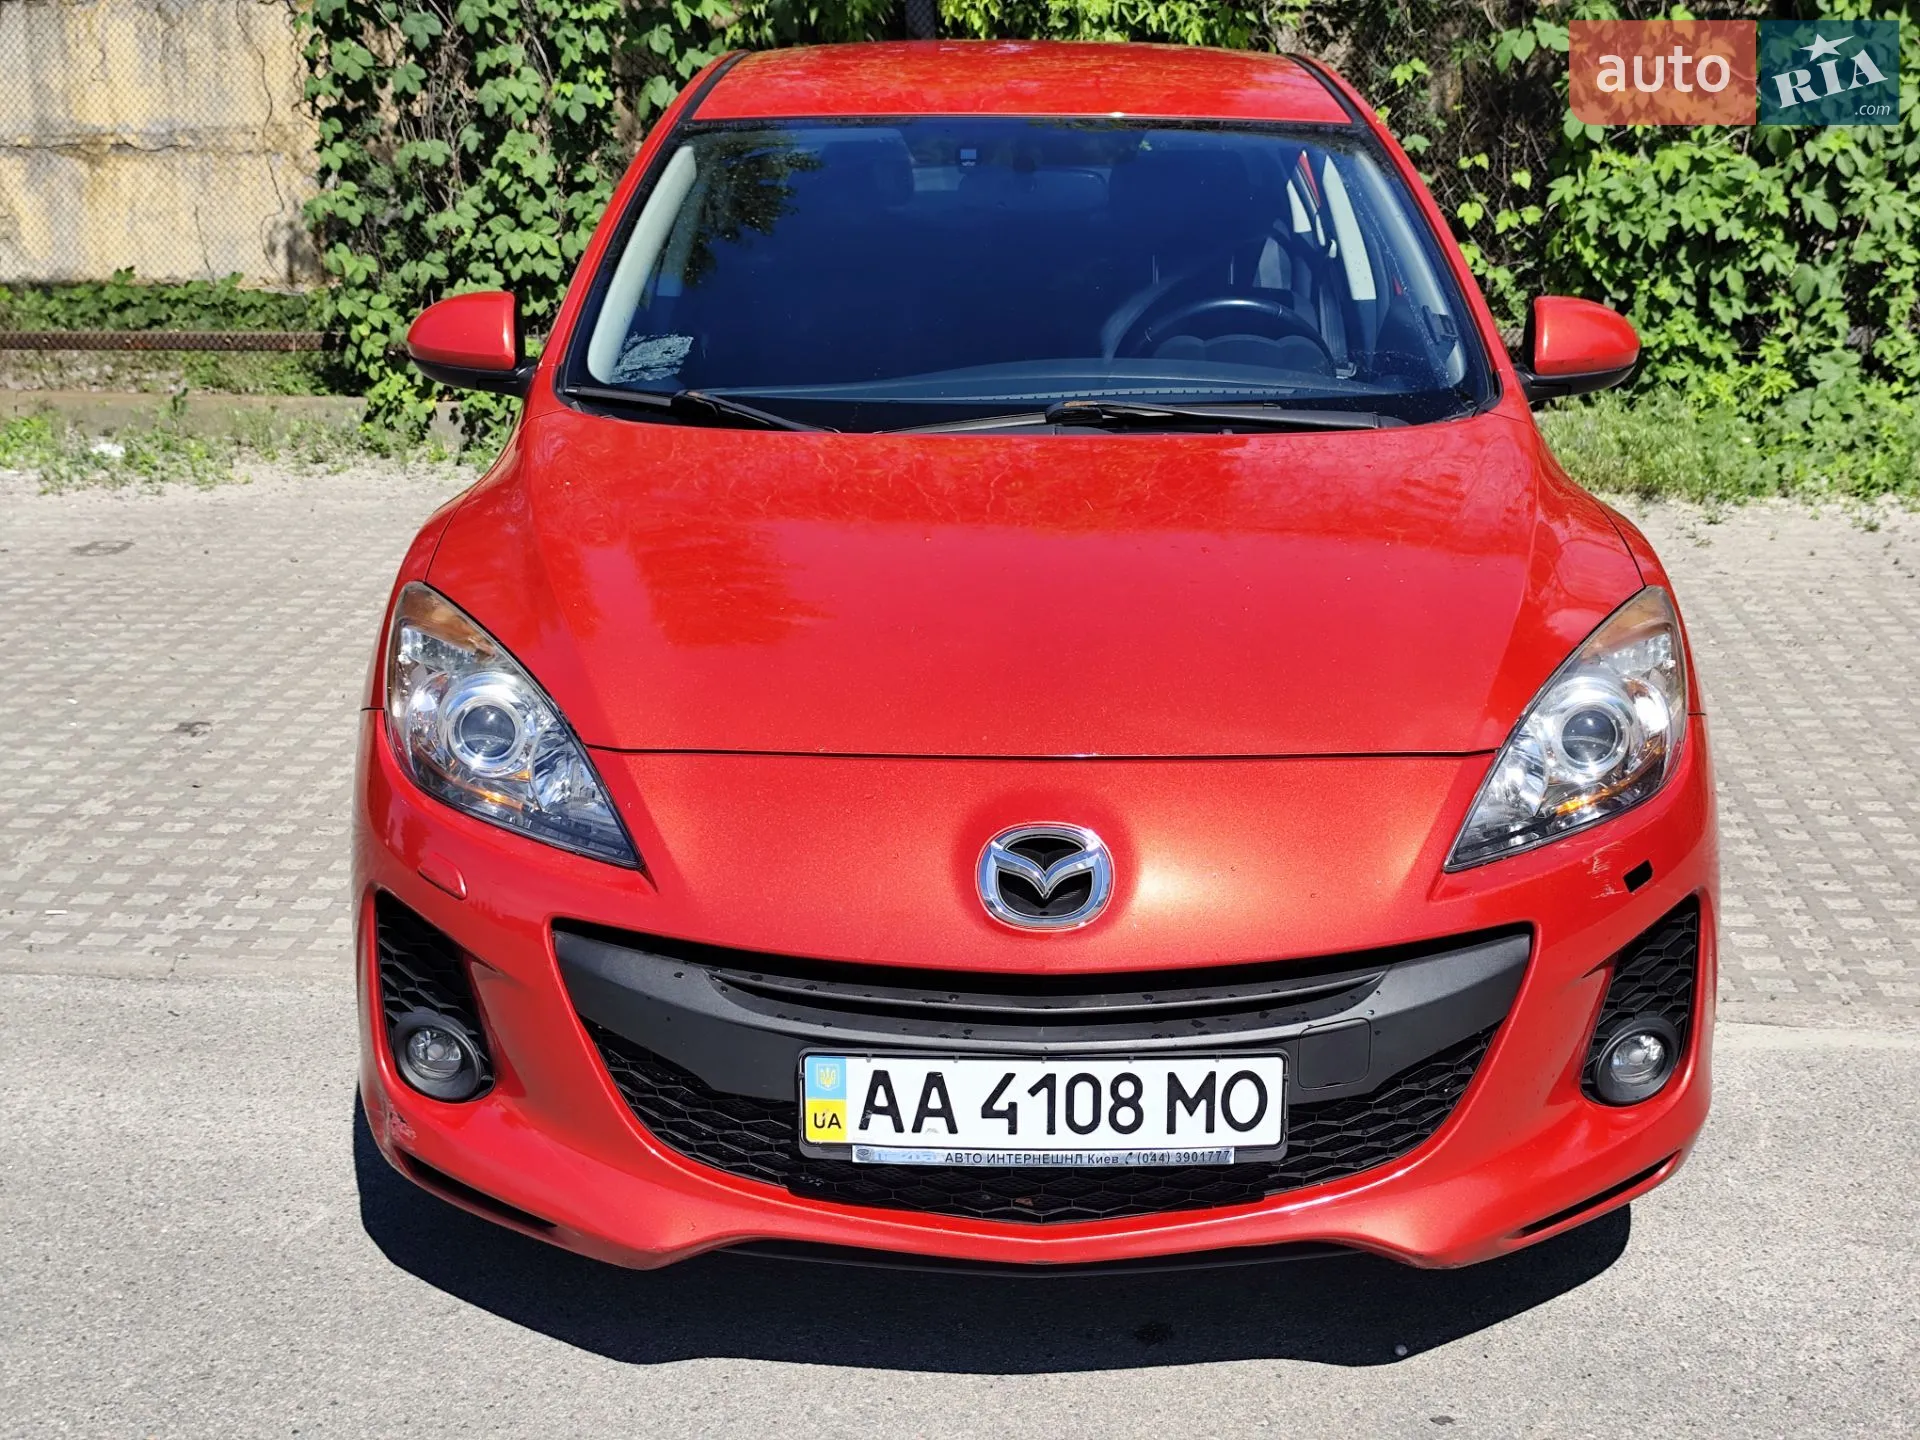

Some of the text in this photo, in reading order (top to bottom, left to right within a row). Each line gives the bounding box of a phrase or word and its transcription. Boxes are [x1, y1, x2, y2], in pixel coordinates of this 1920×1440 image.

[858, 1069, 1269, 1135] AA 4108 MO
[813, 1112, 842, 1130] UA
[945, 1153, 982, 1164] АВТО
[986, 1153, 1083, 1165] ИНТЕРНЕШНЛ
[1087, 1154, 1119, 1165] Киев
[1137, 1152, 1170, 1164] (044)
[1175, 1150, 1231, 1163] 3901777
